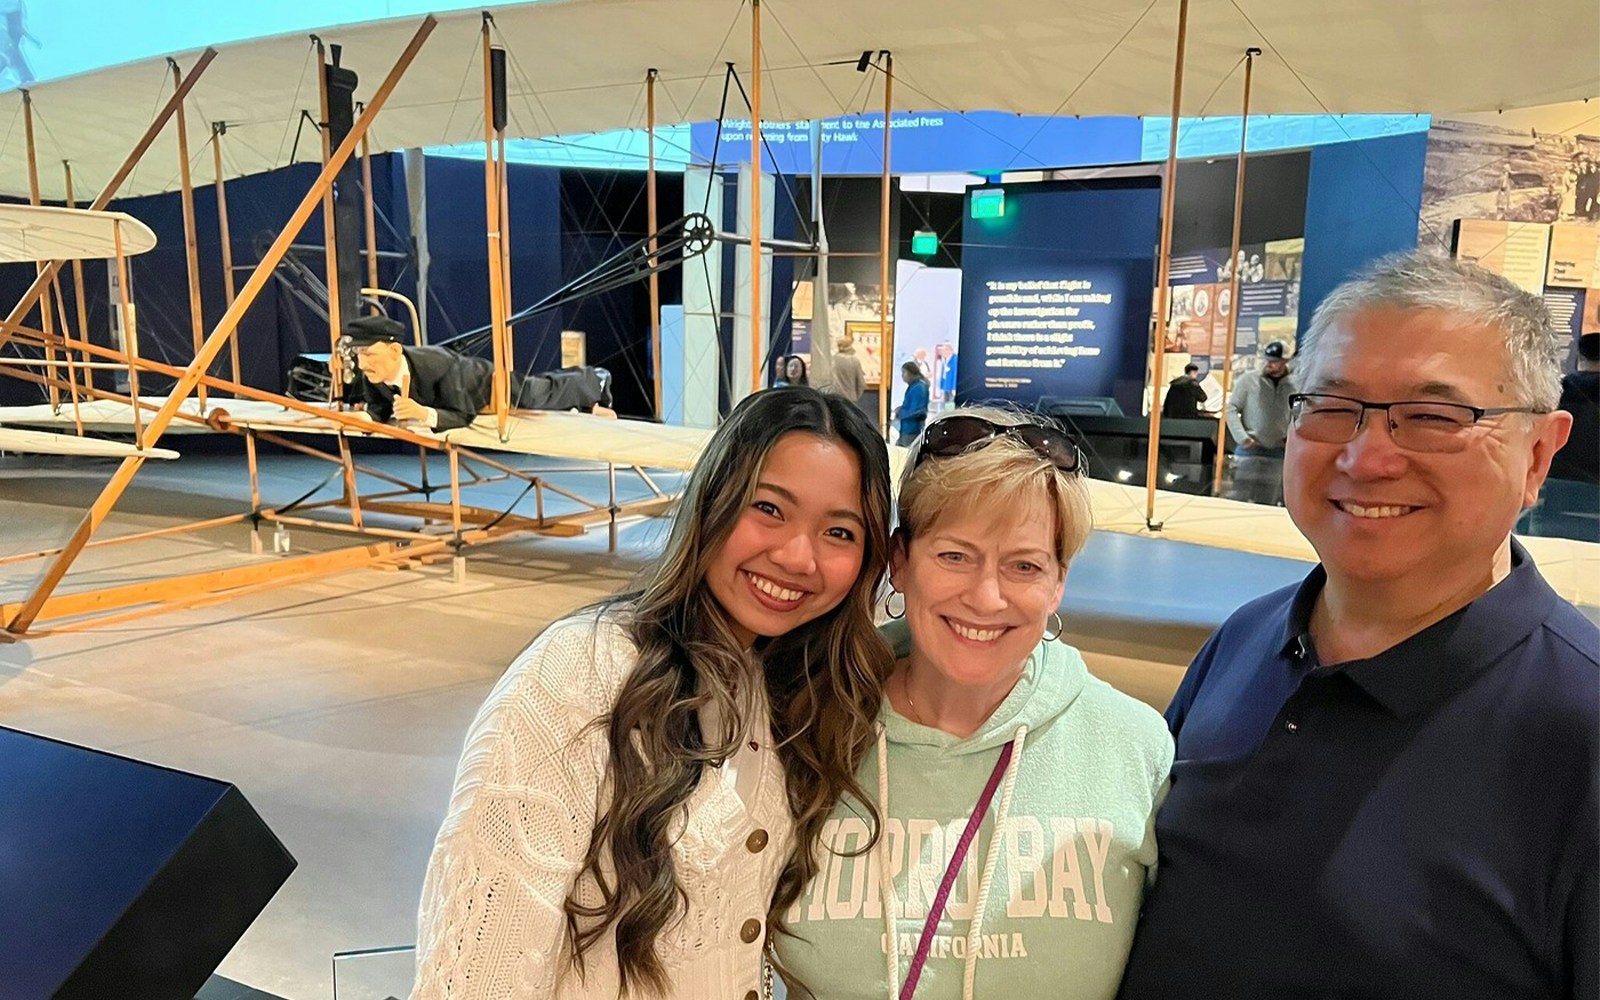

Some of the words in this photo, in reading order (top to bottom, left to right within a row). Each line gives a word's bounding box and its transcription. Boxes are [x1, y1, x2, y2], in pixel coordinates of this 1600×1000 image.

[842, 120, 853, 129] to
[920, 117, 944, 127] Press
[720, 133, 744, 142] upon
[787, 132, 808, 142] from
[833, 132, 858, 142] Hawk
[1007, 815, 1114, 923] BAY
[880, 932, 1028, 959] AIFONIA
